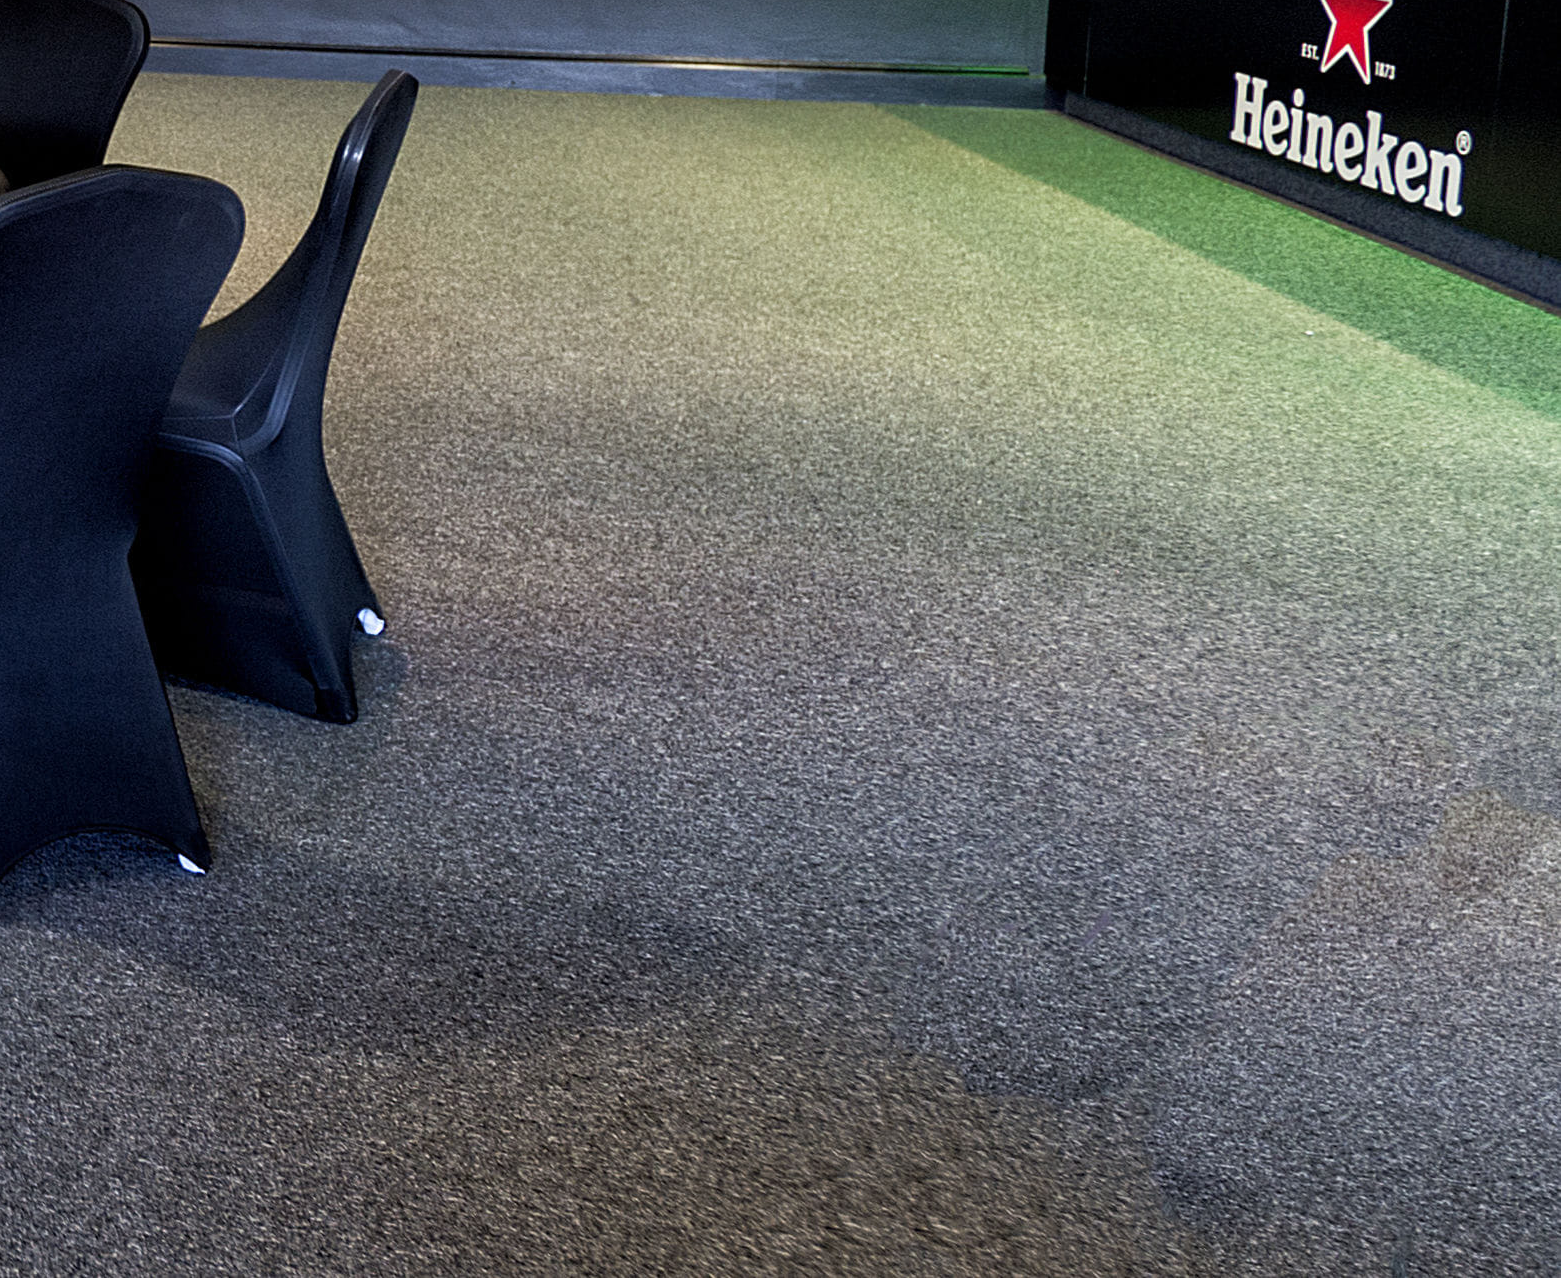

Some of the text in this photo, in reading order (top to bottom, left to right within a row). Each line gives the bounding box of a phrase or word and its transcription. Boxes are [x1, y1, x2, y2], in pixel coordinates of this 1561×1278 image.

[1301, 42, 1320, 61] EST.
[1374, 61, 1396, 80] 1873
[1230, 71, 1463, 217] Heineken
